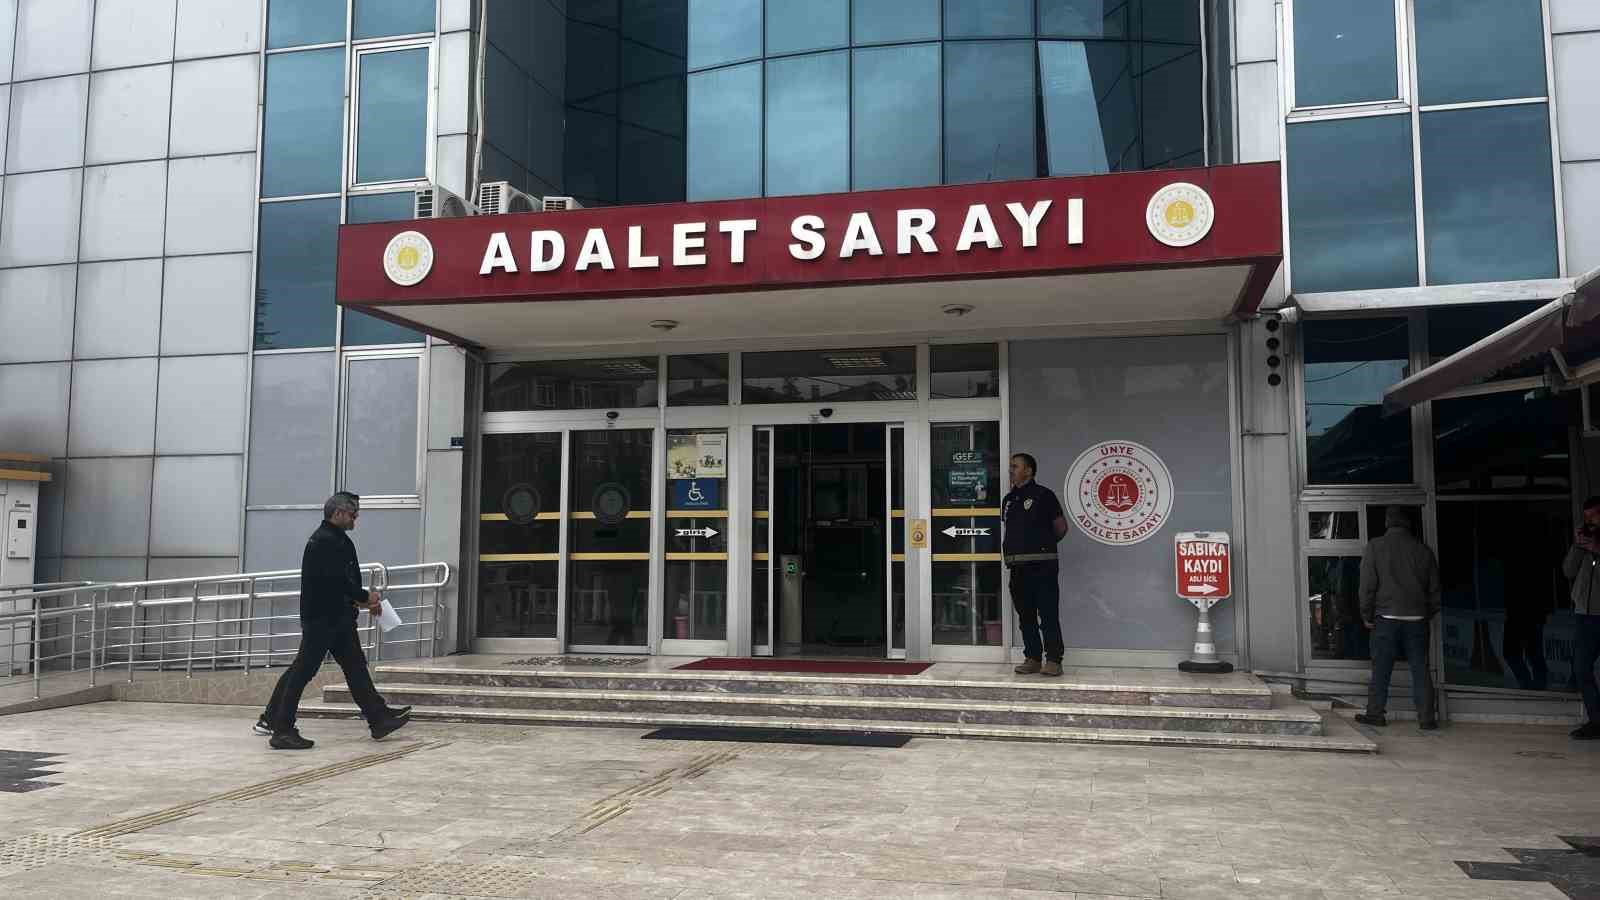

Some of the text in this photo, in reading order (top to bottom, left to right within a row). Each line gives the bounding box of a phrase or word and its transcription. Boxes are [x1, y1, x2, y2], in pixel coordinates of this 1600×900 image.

[479, 198, 1084, 276] ADALET SARAYI
[1101, 445, 1135, 456] ÜNYE
[1077, 512, 1162, 540] ADALET SARAYI
[1179, 542, 1226, 557] SABIKA
[1184, 559, 1223, 573] KAYDI
